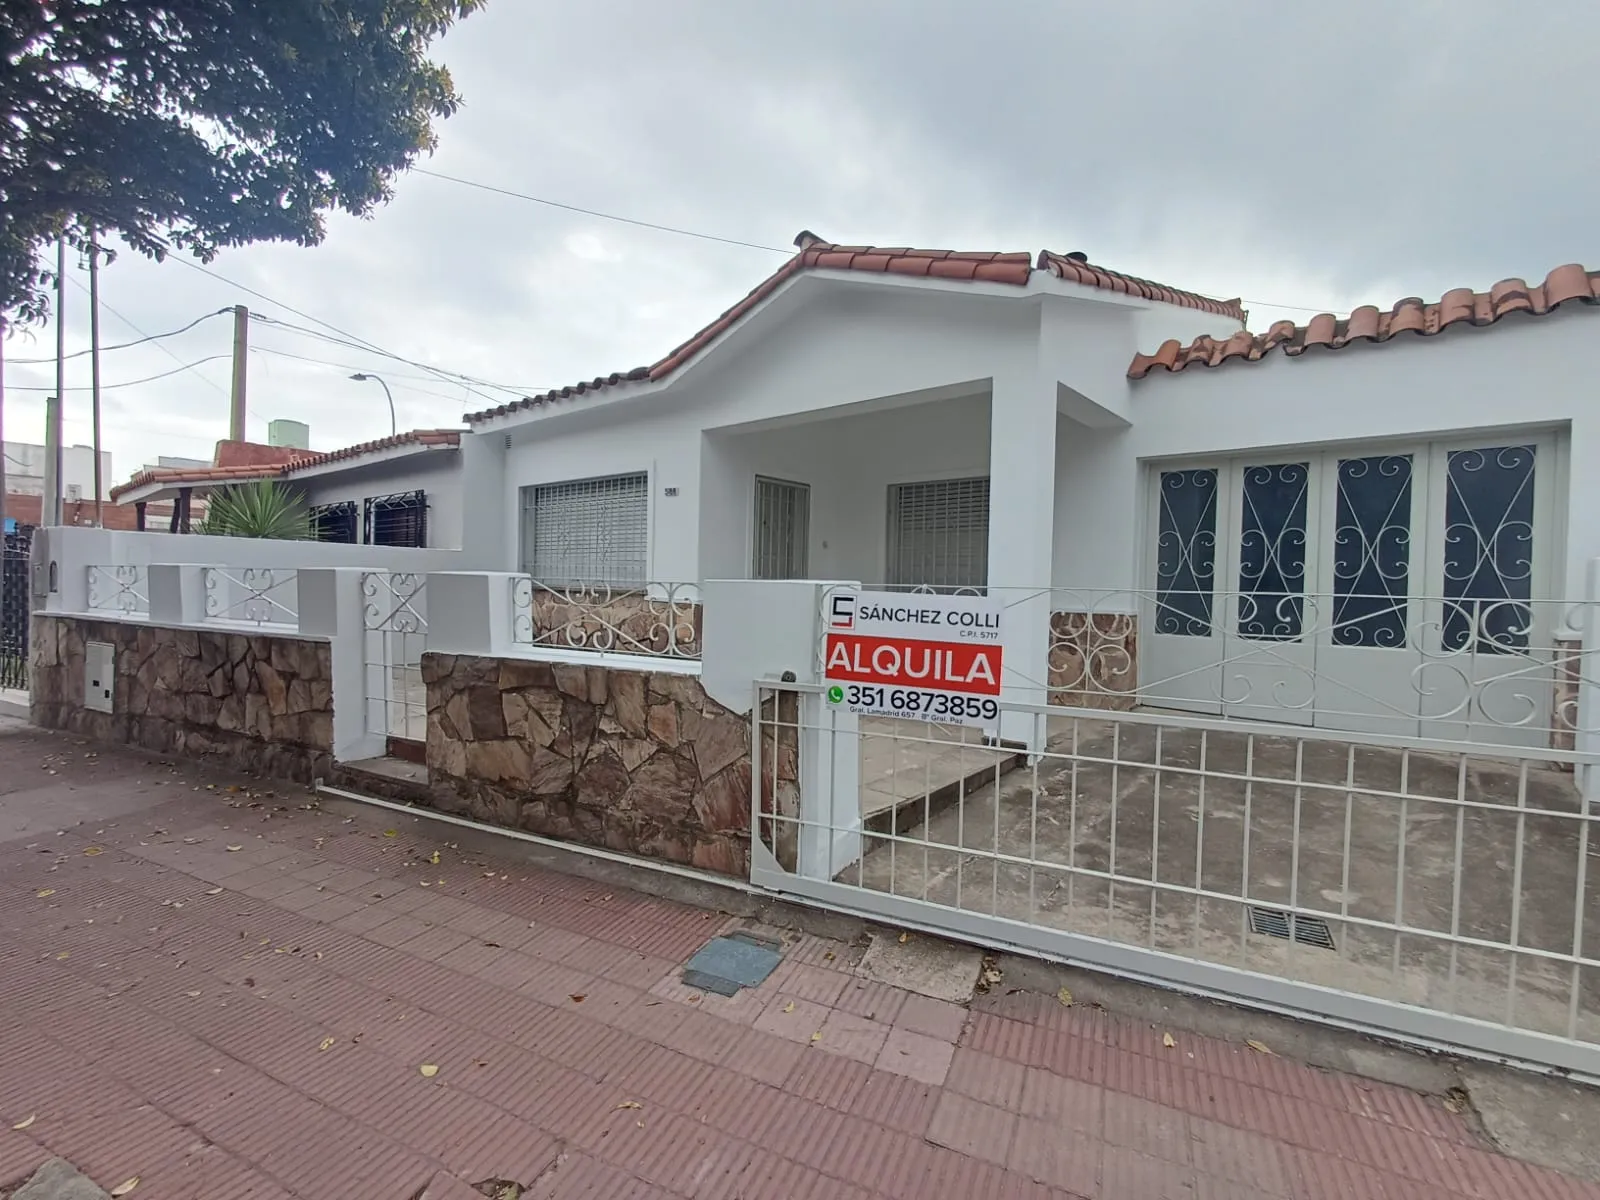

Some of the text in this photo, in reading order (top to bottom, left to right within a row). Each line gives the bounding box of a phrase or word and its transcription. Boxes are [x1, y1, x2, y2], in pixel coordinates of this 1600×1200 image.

[859, 603, 1000, 629] SÁNCHEZ COLLI
[959, 630, 999, 640] C.P.I. 5717
[827, 641, 996, 686] ALQUILA
[847, 685, 998, 721] 351 6873859
[849, 705, 866, 714] Gral.
[866, 707, 900, 718] Lamadrid
[901, 710, 916, 719] 657
[930, 714, 948, 723] Gral.
[949, 716, 964, 725] Paz
